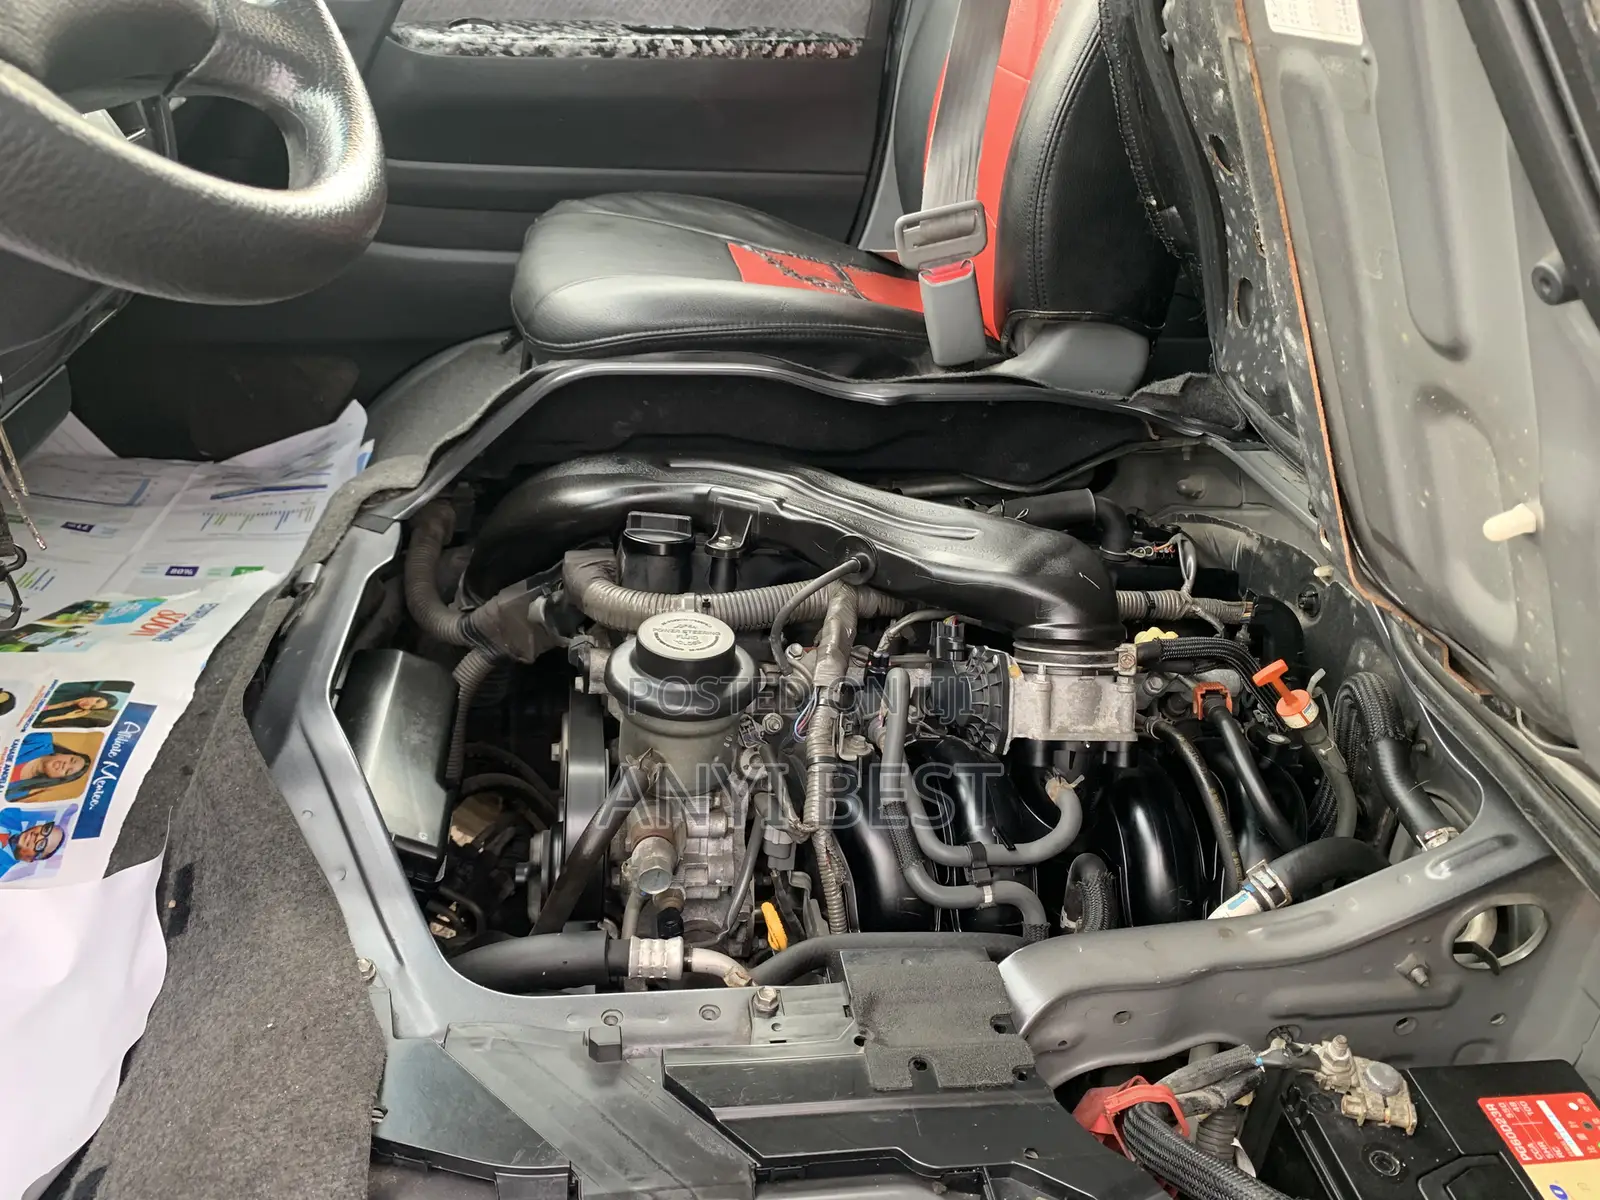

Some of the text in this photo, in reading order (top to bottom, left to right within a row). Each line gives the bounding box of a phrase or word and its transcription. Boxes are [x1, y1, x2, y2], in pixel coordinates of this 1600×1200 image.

[1519, 1100, 1535, 1117] 100
[1485, 1103, 1532, 1161] PG60D23R
[1508, 1101, 1555, 1159] SHR 48
[1527, 1142, 1544, 1160] CCA
